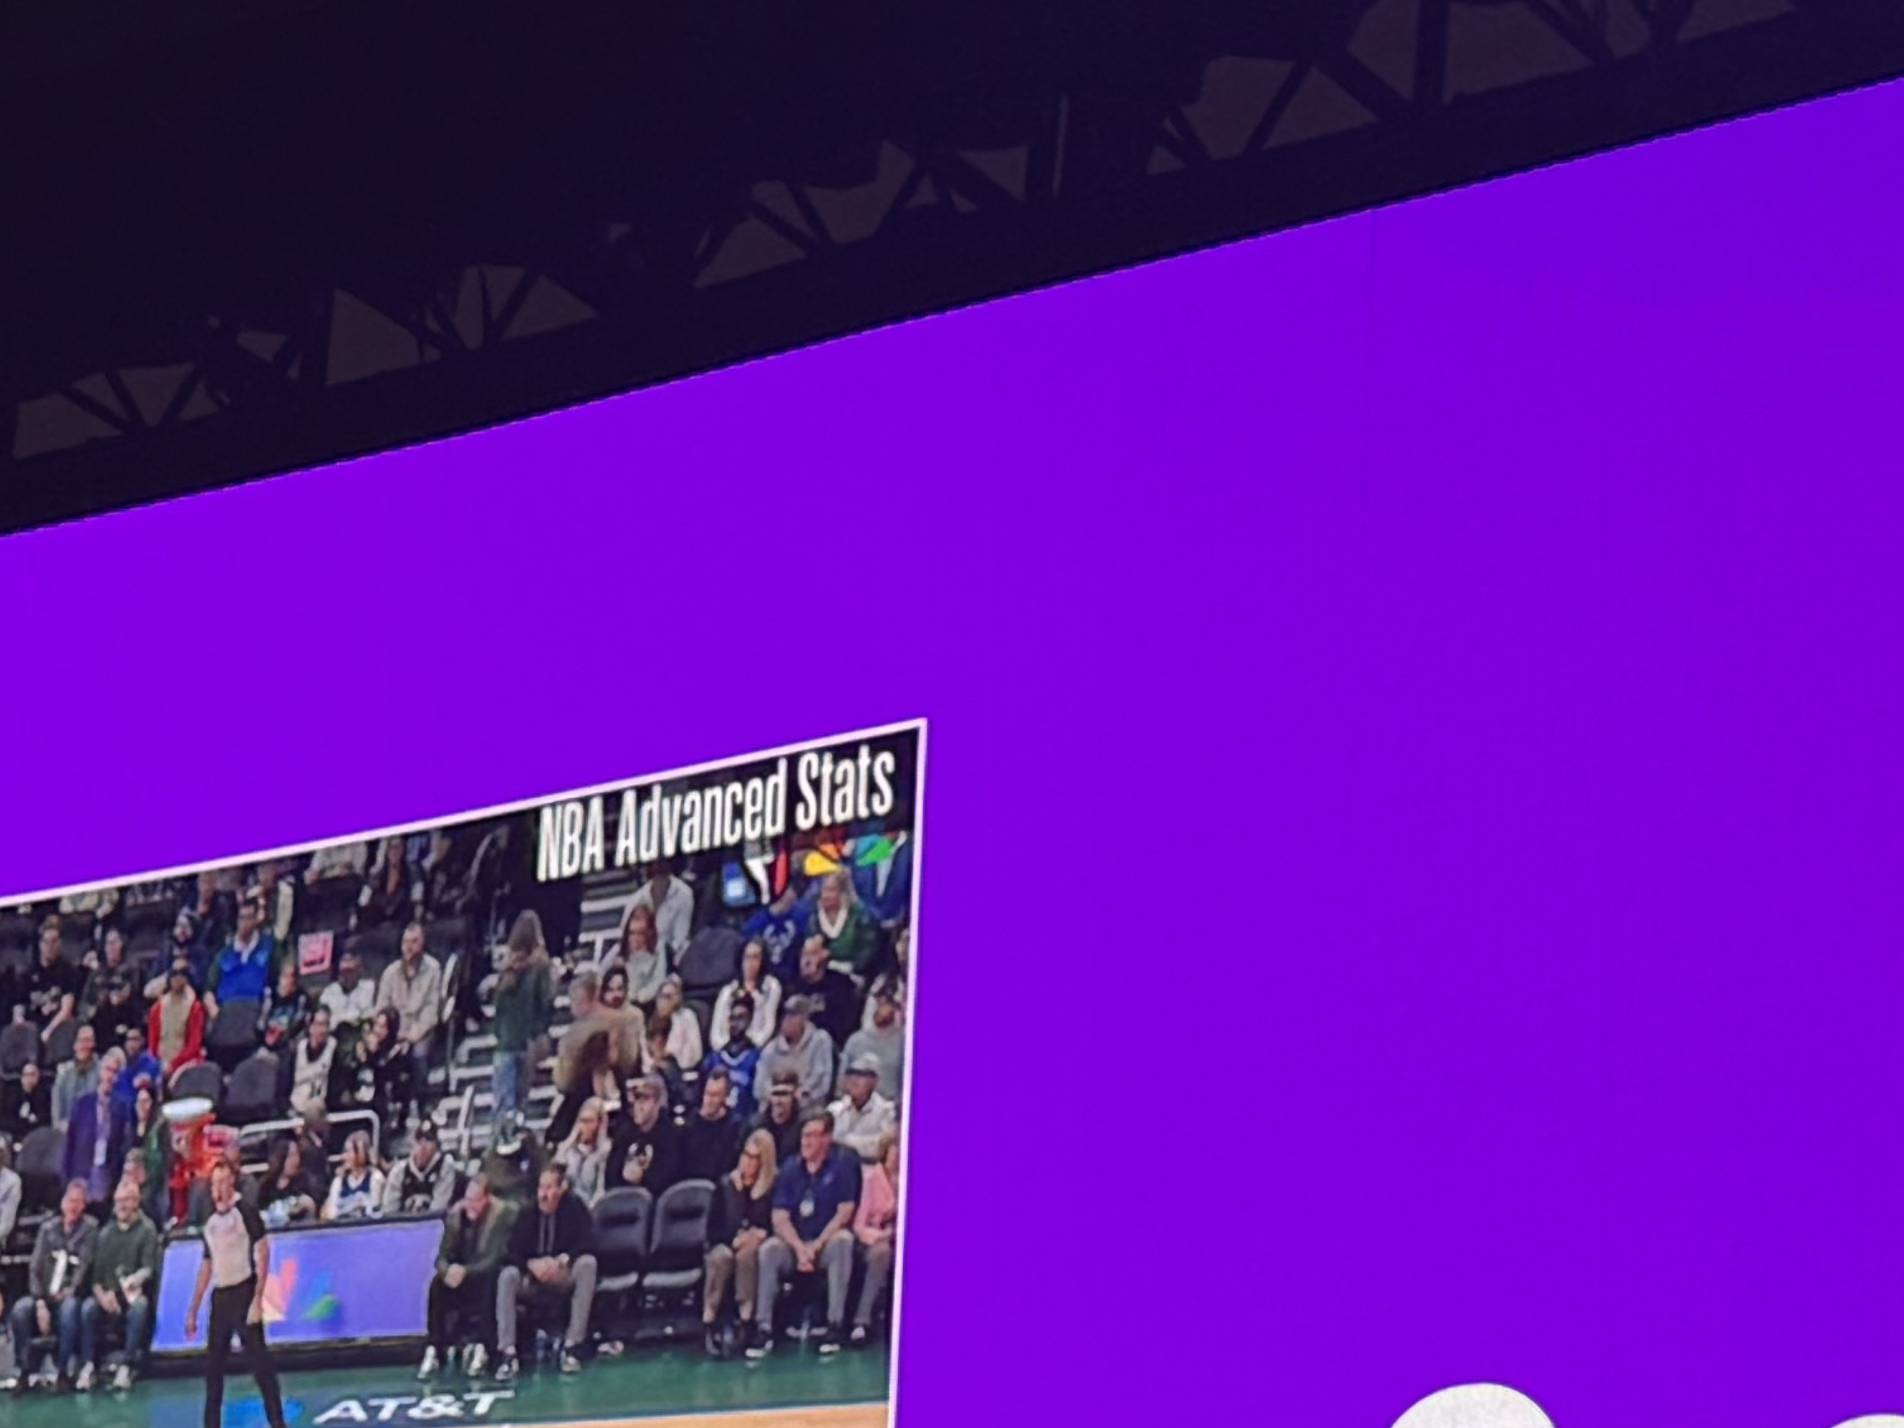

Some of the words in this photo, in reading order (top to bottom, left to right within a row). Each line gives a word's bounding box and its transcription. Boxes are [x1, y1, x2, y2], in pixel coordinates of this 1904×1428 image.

[537, 797, 605, 882] NBA
[615, 757, 788, 868] Advanced
[796, 744, 896, 831] Stats
[313, 1389, 516, 1425] AT&T
